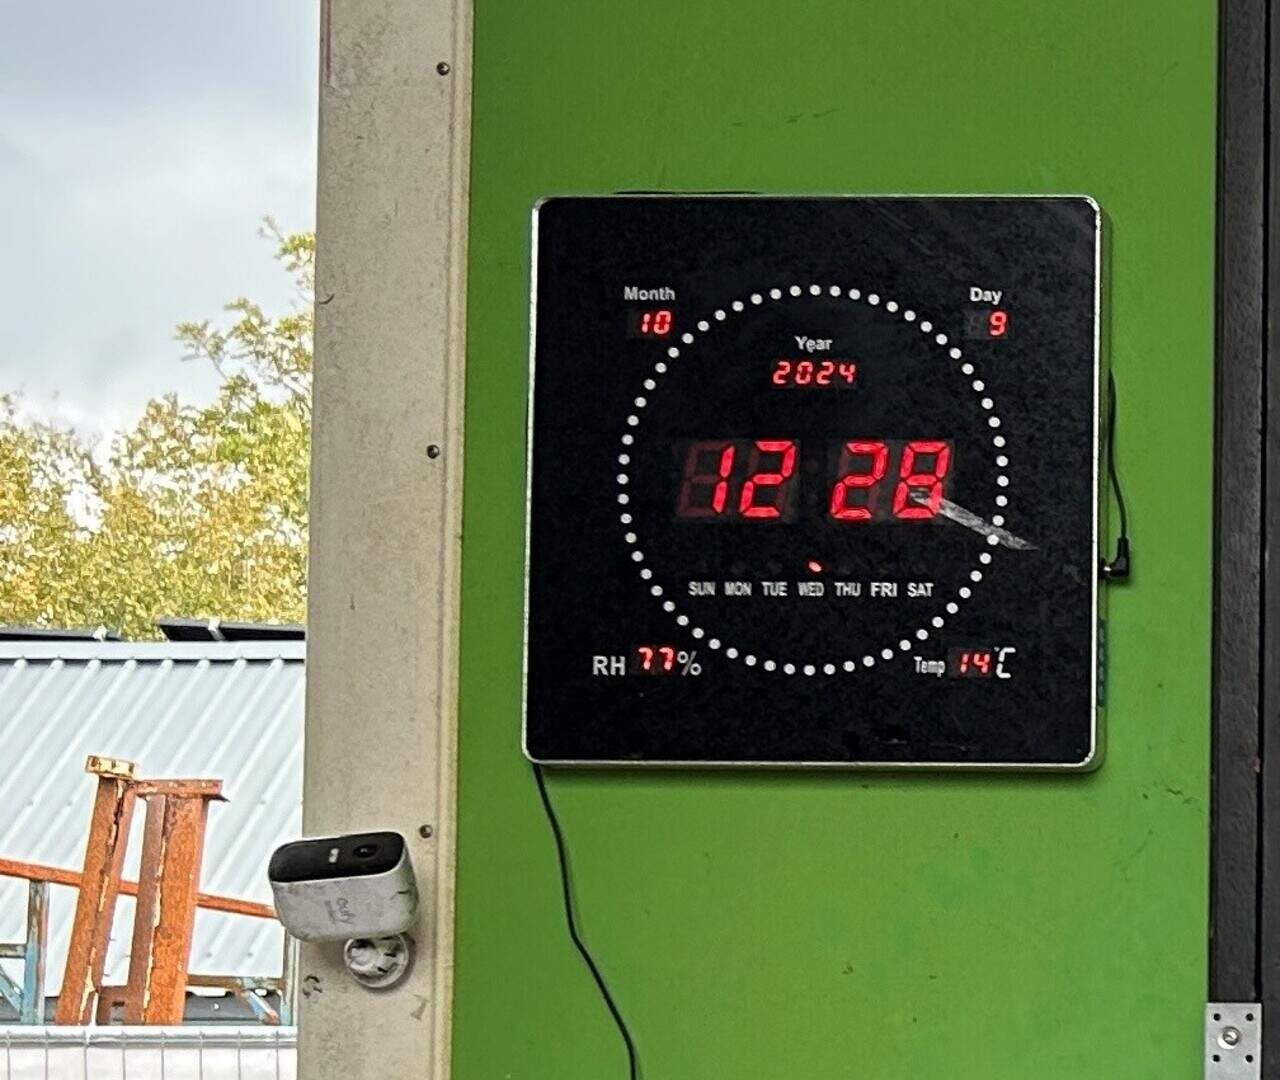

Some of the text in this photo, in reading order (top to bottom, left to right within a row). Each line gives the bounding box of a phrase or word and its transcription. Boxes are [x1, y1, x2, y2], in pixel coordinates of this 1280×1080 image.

[624, 286, 676, 301] Month
[969, 286, 1003, 304] Day
[640, 310, 672, 335] 10
[988, 310, 1009, 336] 9
[794, 336, 833, 352] Year
[772, 360, 857, 385] 2024
[712, 440, 951, 520] 12 28
[688, 581, 934, 598] SUN MON TUE WED THU FRI SAT
[592, 655, 626, 676] RH
[913, 655, 946, 678] Temp
